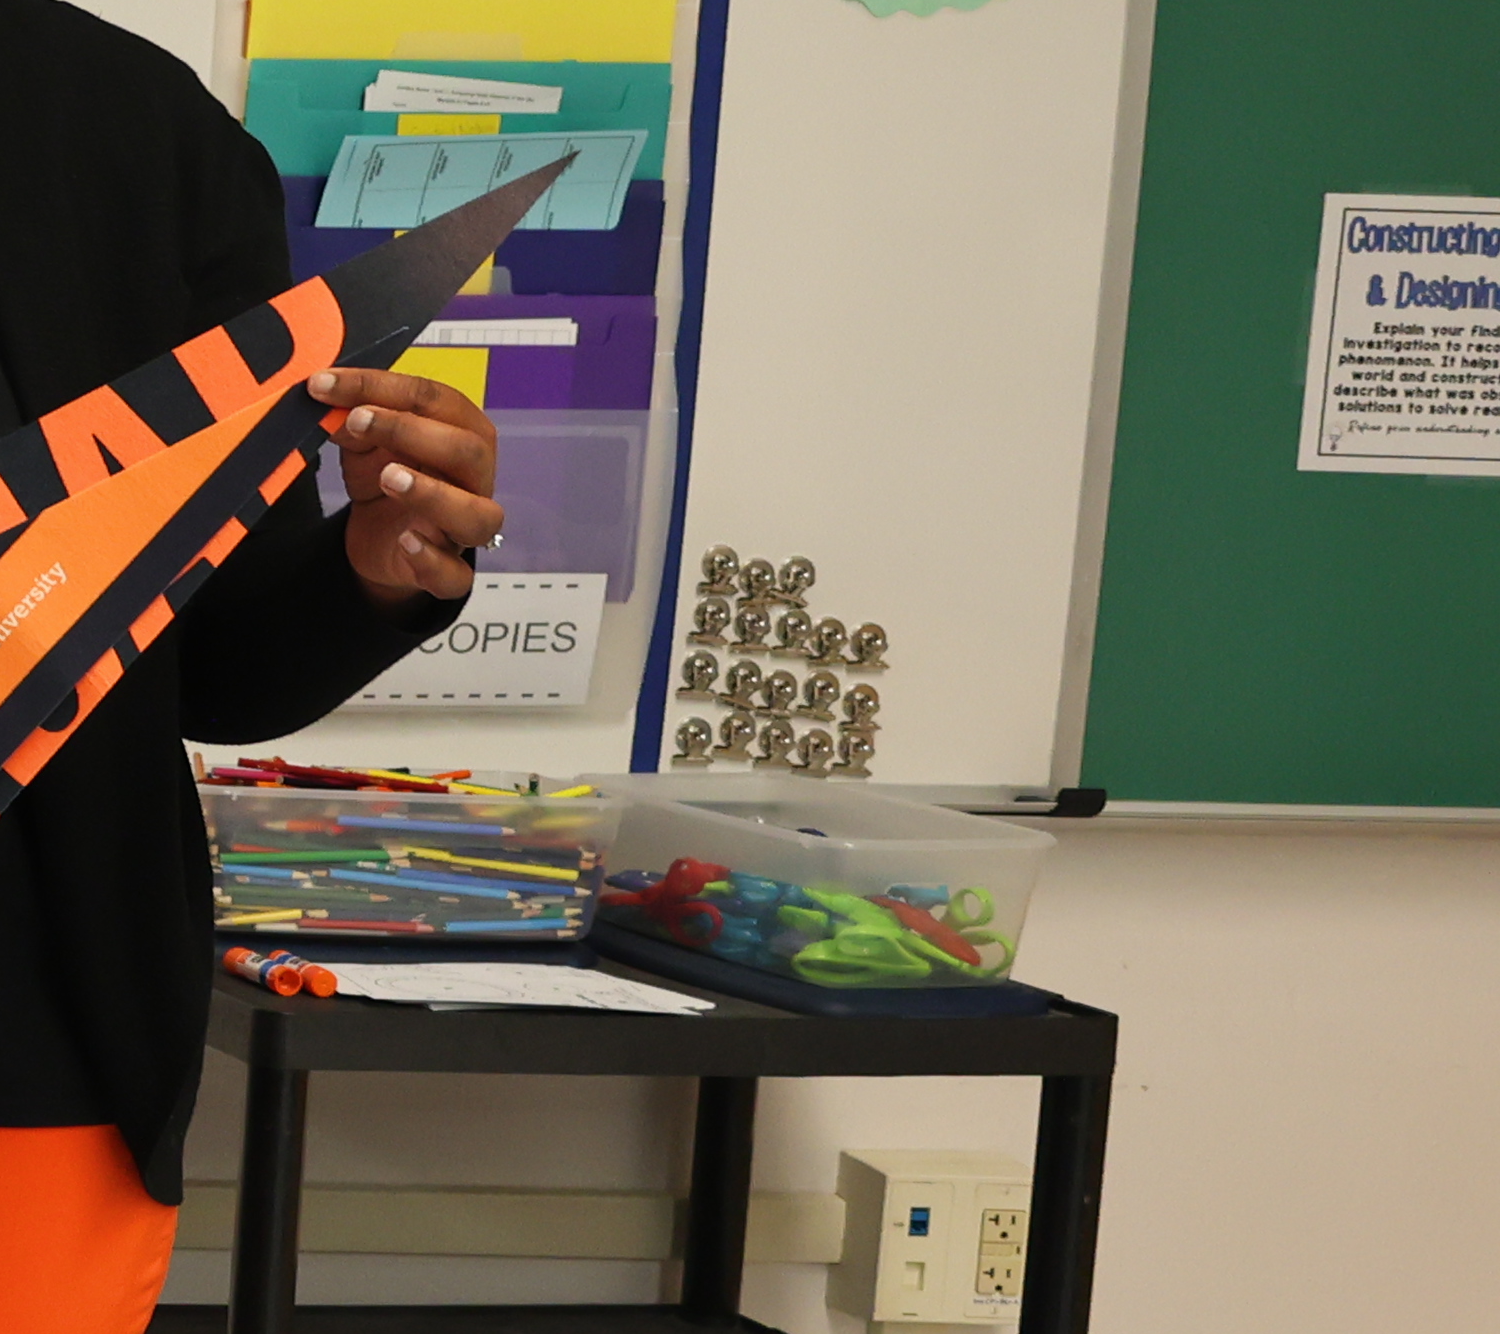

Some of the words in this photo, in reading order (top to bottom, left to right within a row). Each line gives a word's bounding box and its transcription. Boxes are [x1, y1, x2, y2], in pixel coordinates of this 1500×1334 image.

[1366, 273, 1388, 307] &
[1373, 320, 1426, 337] Explain
[1431, 324, 1465, 338] your
[1446, 340, 1461, 351] to
[1338, 353, 1435, 368] phenomenon.
[1441, 354, 1456, 367] It
[1461, 355, 1500, 371] helps
[1351, 369, 1394, 382] world
[1399, 370, 1426, 383] and
[1333, 384, 1398, 397] describe
[1404, 386, 1441, 399] what
[1446, 389, 1475, 400] was
[1338, 401, 1402, 414] solutions
[1408, 402, 1424, 415] to
[1428, 402, 1469, 415] solve
